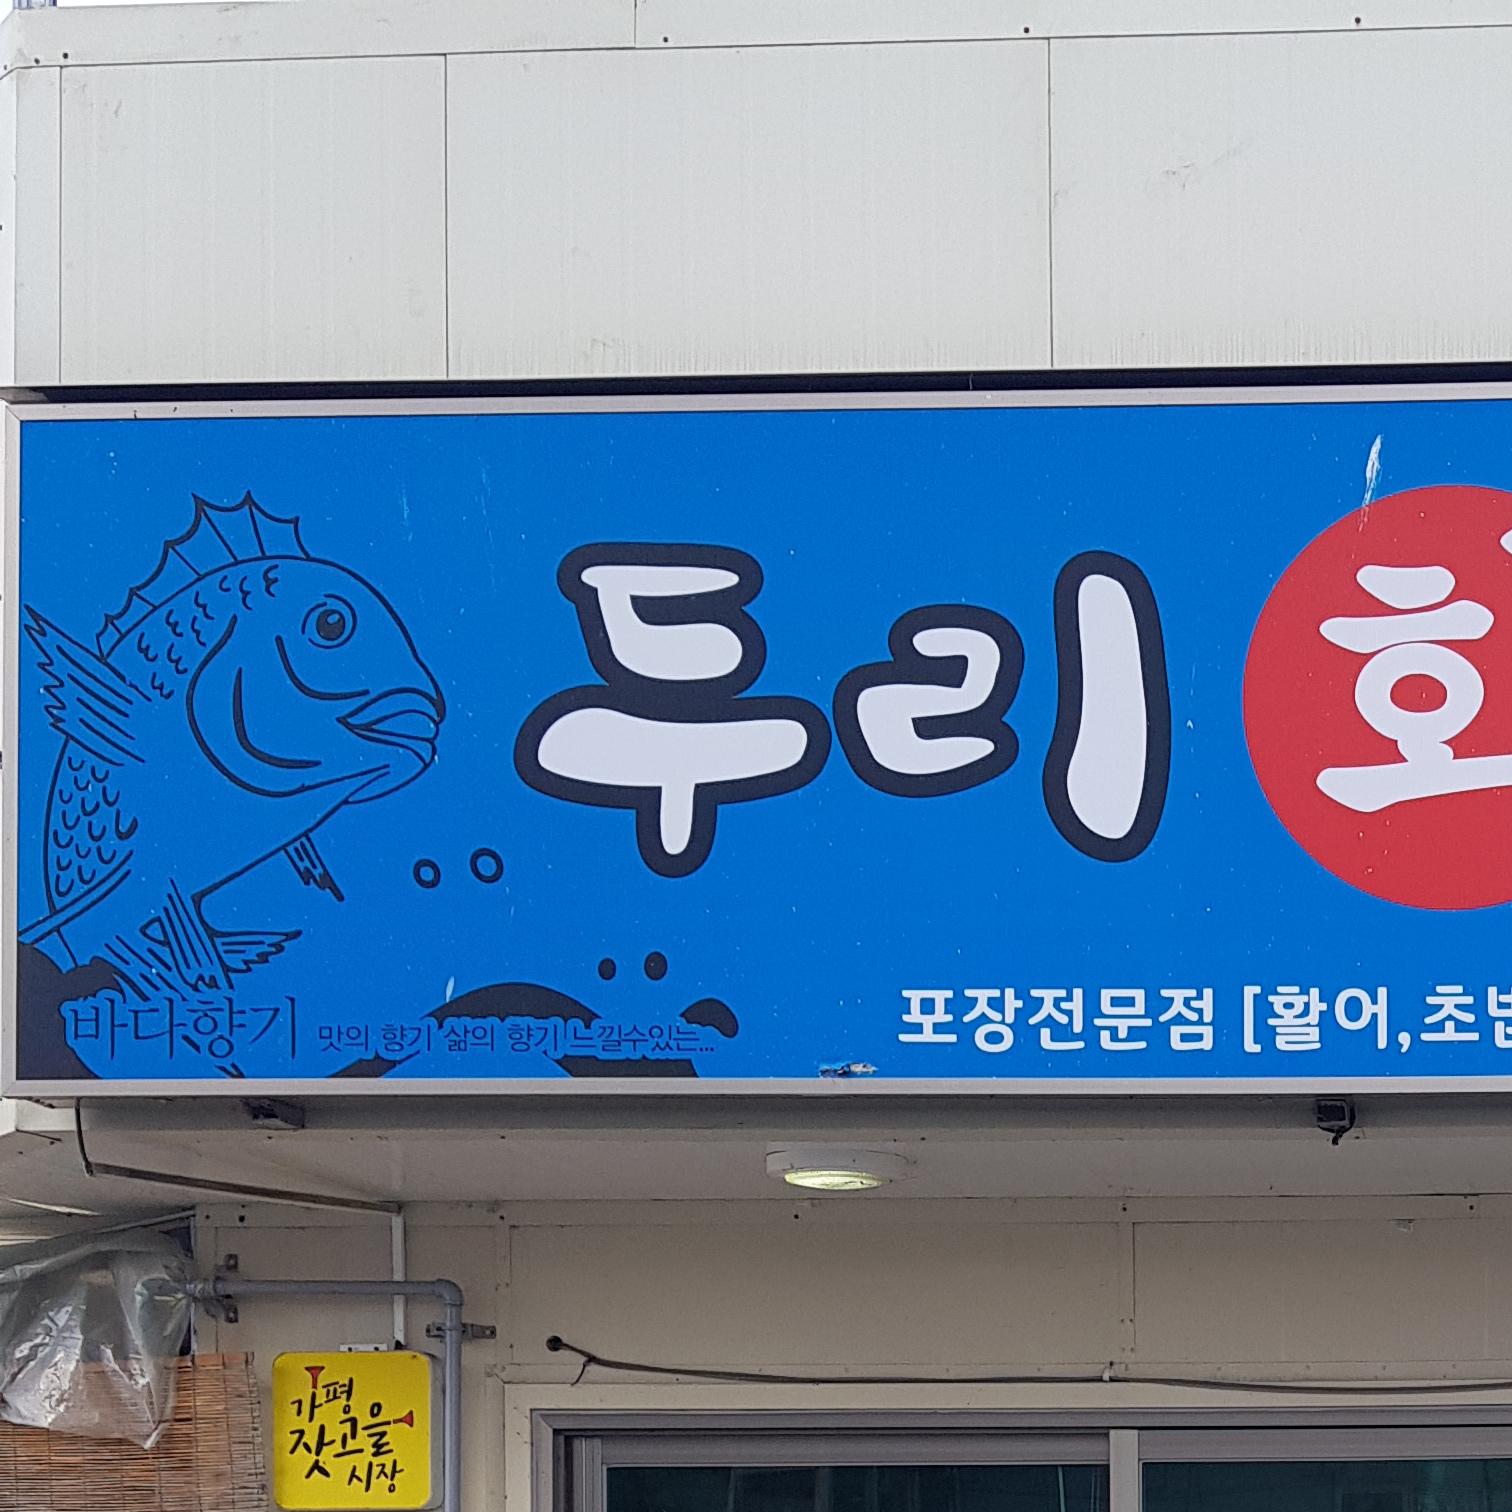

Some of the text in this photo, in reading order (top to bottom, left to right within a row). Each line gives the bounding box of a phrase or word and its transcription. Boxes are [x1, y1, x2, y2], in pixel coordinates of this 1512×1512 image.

[514, 541, 1171, 878] 두리
[69, 996, 296, 1060] 바다향기
[318, 1023, 369, 1053] 맛의
[381, 1023, 433, 1054] 향기
[443, 1024, 496, 1053] 삶의
[507, 1023, 559, 1053] 향기
[898, 985, 1215, 1053] 포장전문점
[290, 1377, 354, 1423] 가평
[289, 1402, 394, 1479] 잣고을
[347, 1459, 404, 1493] 시장
